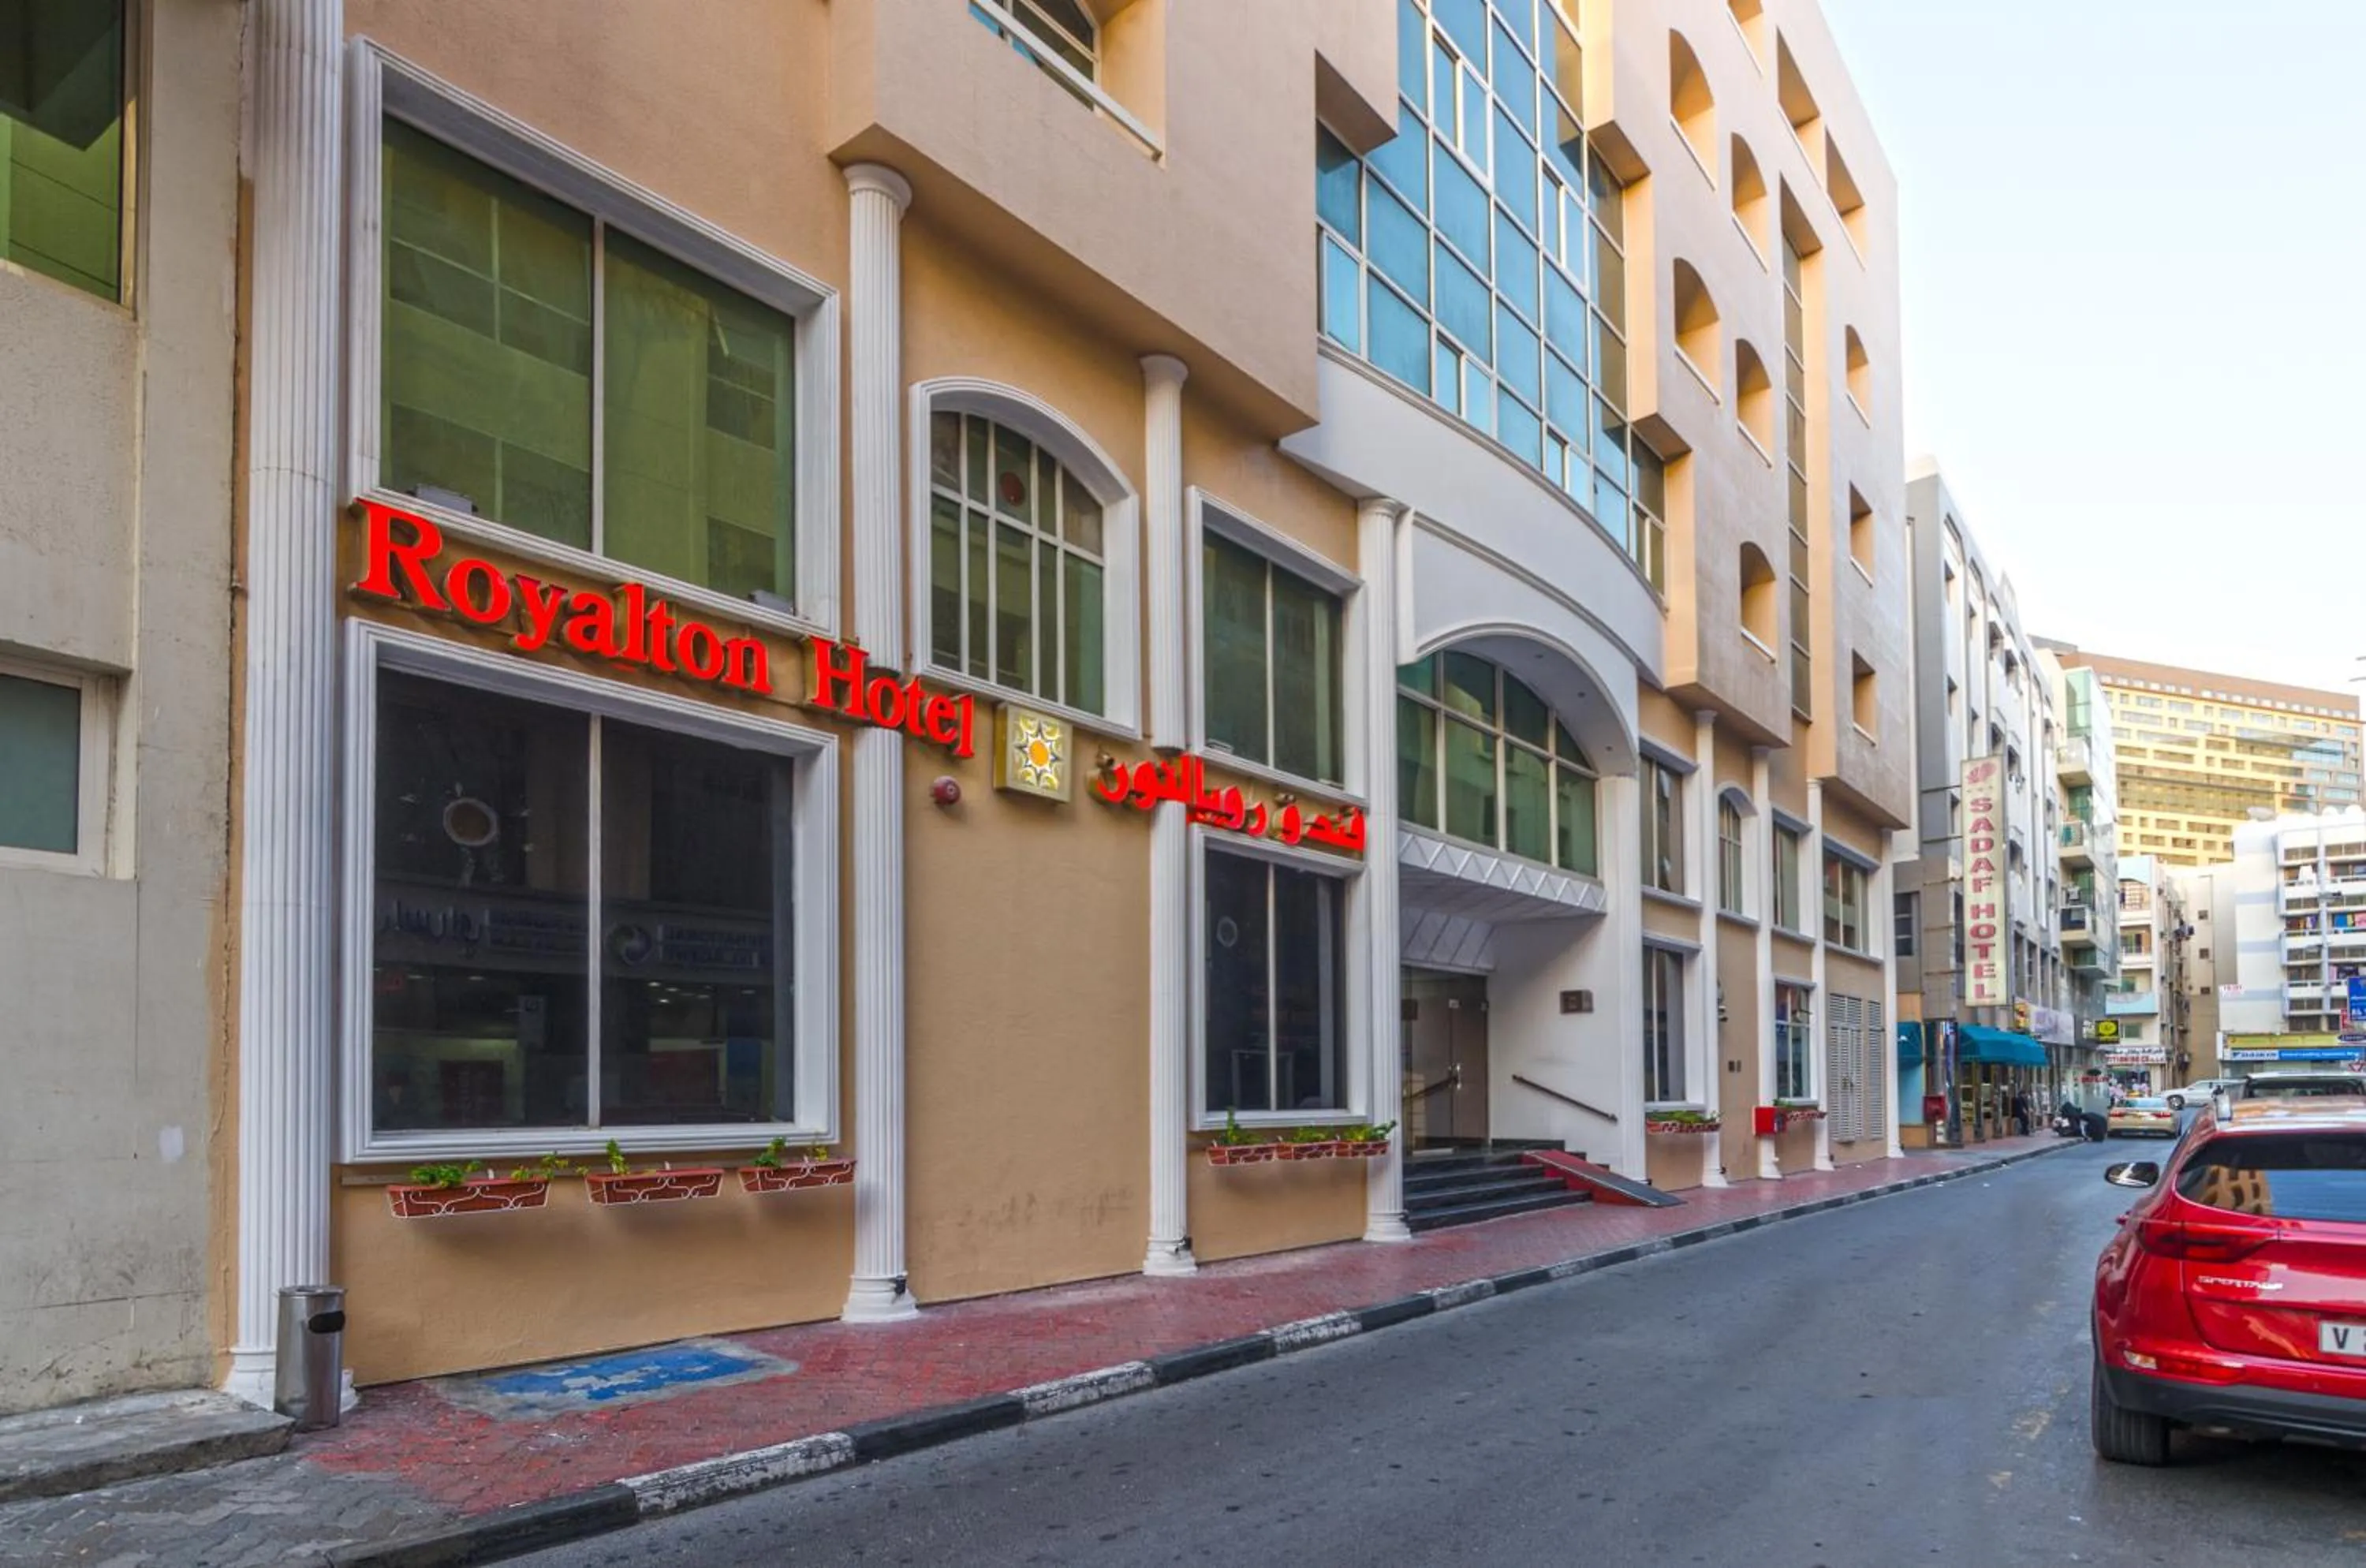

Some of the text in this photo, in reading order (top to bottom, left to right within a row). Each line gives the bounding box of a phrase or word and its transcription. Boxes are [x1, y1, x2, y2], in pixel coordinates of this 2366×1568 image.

[357, 502, 975, 758] Royalton Hotel
[1969, 797, 1996, 1000] SADAF HOTEL
[2332, 1327, 2349, 1350] V
